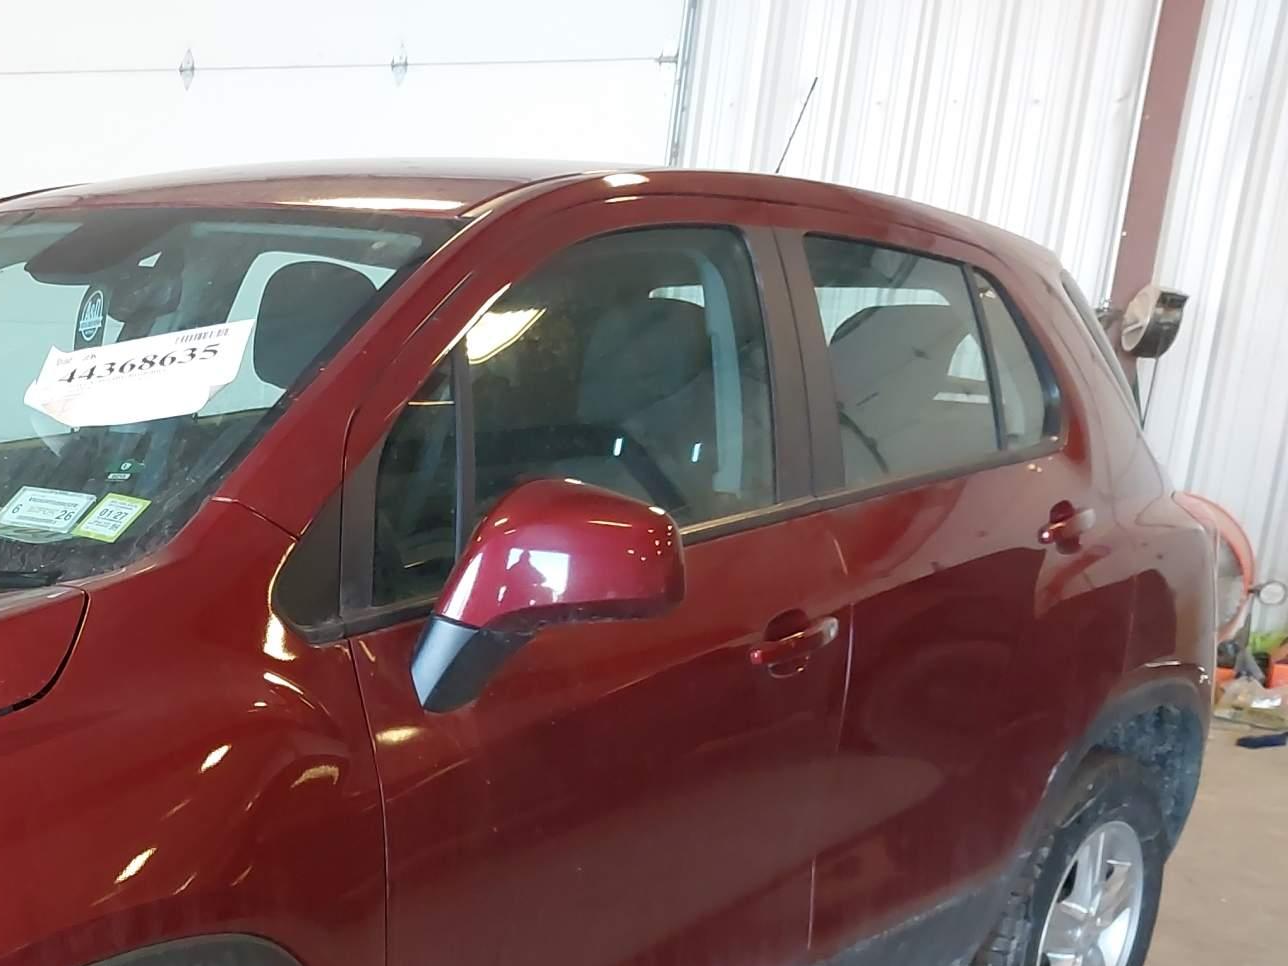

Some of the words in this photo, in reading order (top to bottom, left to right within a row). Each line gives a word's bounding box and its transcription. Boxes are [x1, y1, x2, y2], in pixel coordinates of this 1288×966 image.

[58, 342, 221, 384] 44368635
[11, 503, 23, 514] 6
[55, 509, 75, 521] 26
